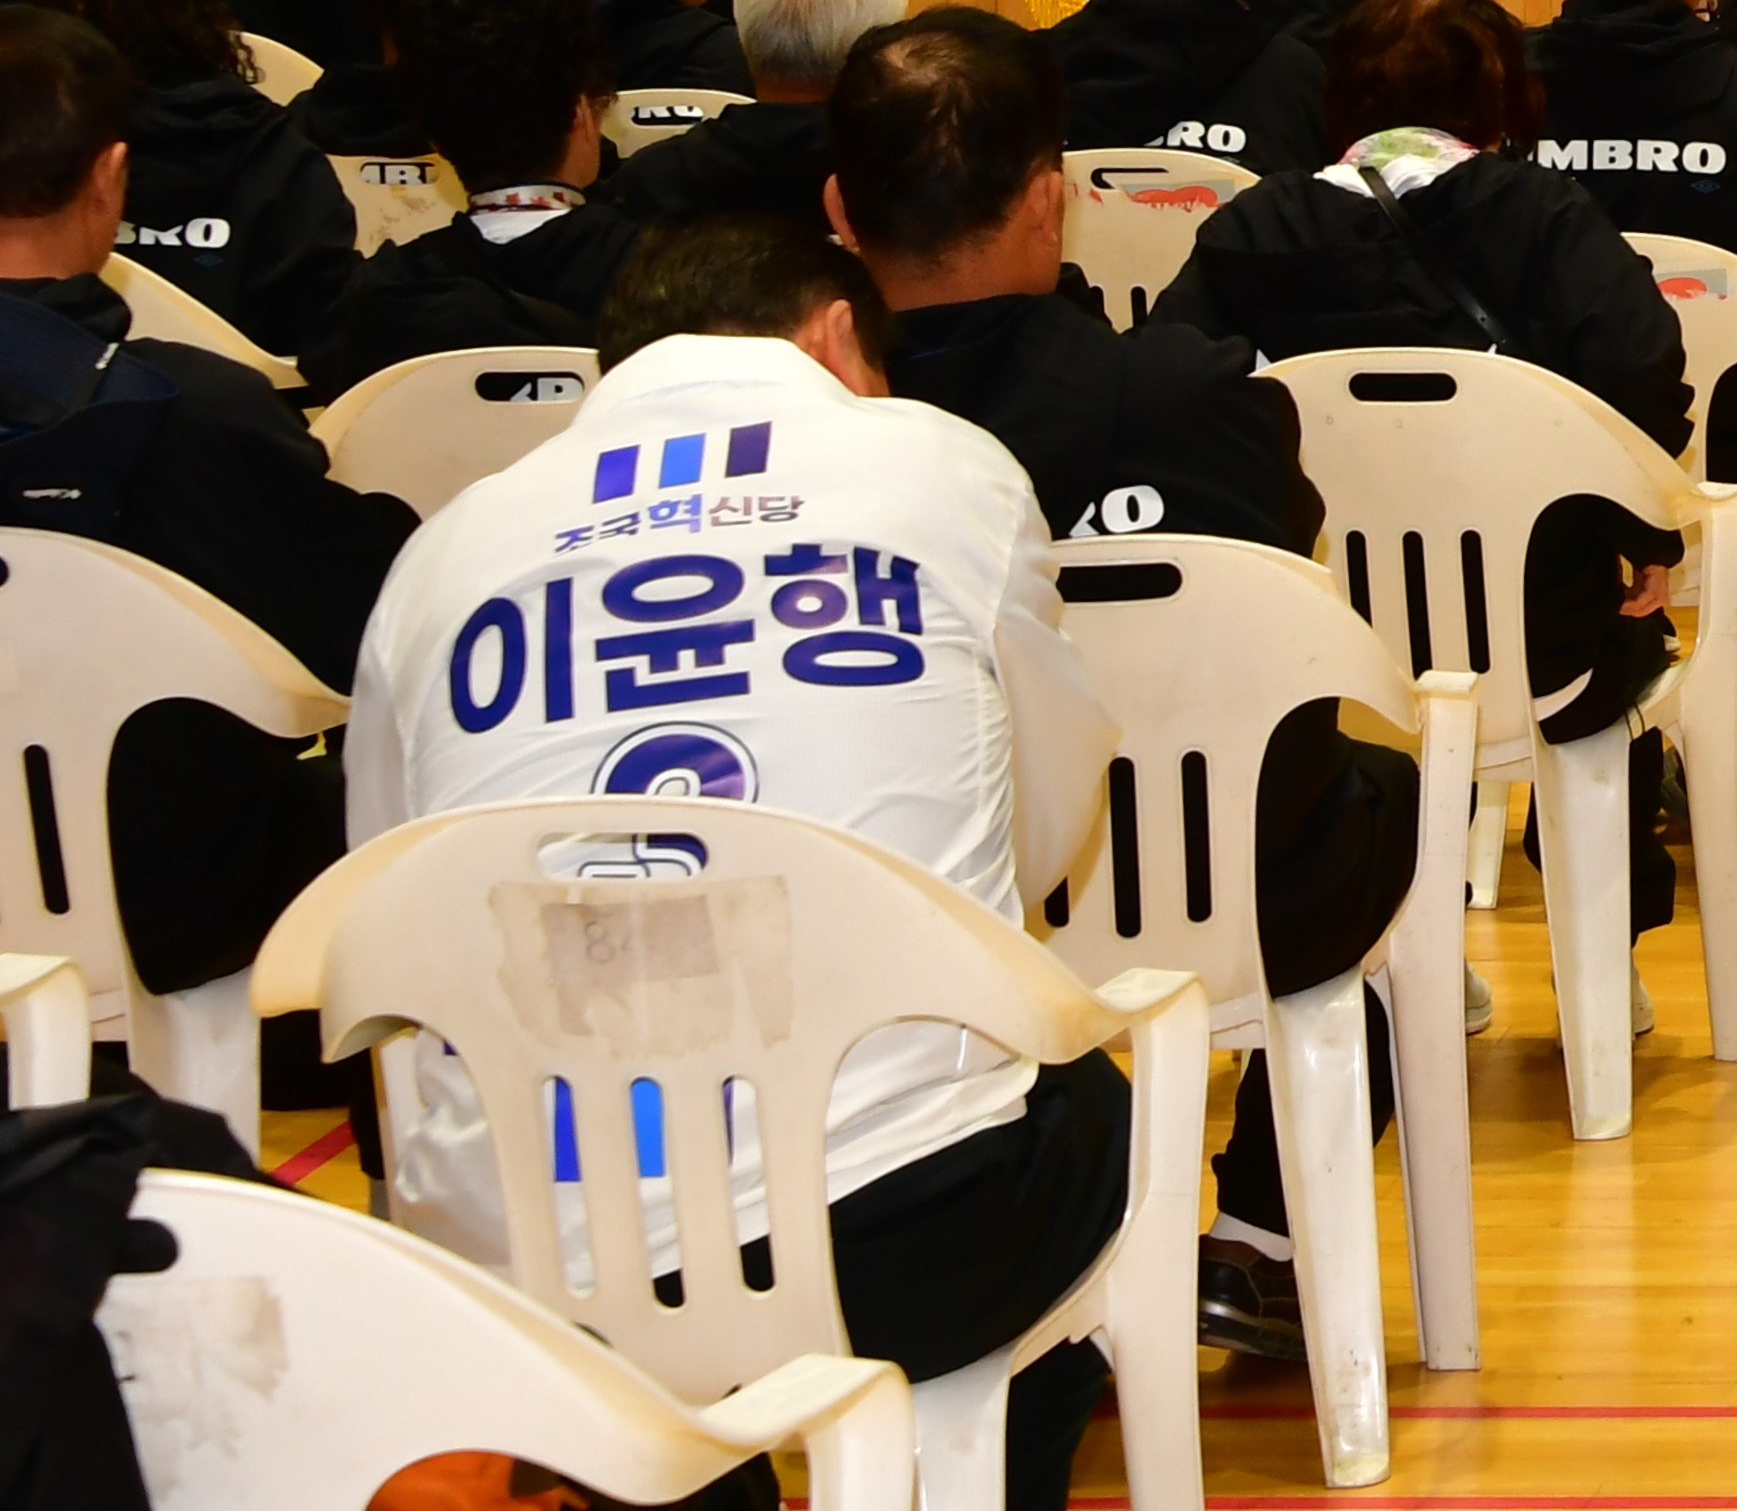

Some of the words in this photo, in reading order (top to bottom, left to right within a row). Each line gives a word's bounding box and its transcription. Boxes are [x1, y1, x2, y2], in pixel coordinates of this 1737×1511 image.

[1144, 120, 1247, 153] RO
[1528, 139, 1727, 175] MBRO
[555, 493, 805, 556] 조국혁신당
[449, 541, 925, 735] 이윤행
